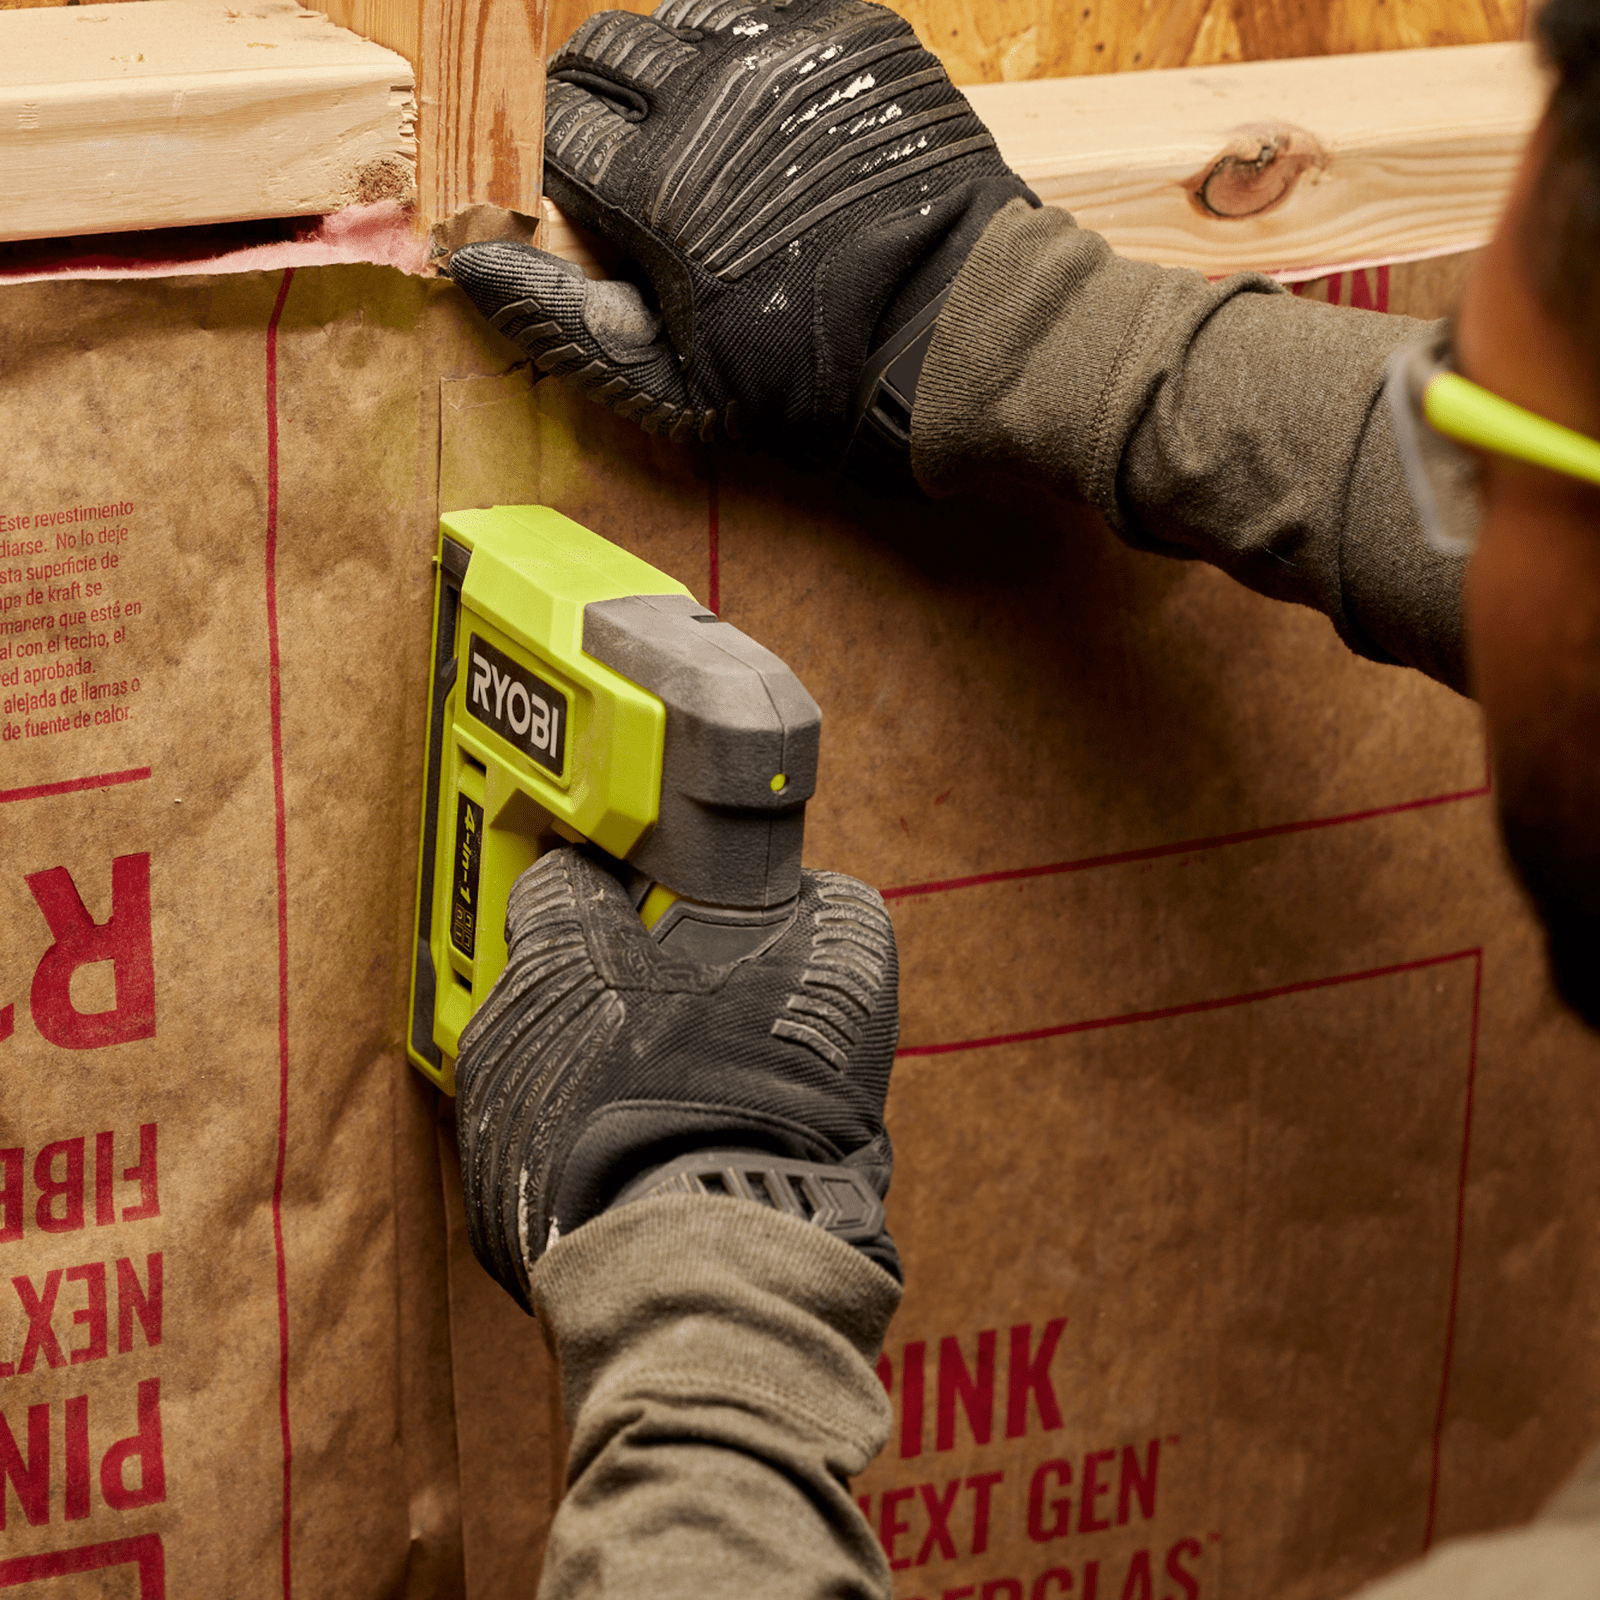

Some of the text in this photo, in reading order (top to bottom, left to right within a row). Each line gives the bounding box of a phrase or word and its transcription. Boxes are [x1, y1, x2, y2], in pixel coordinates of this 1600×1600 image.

[0, 501, 134, 533] Este revestimiento
[0, 525, 129, 559] diarse. No lo deje
[0, 551, 119, 585] sta superficie de
[25, 587, 44, 606] de
[48, 581, 82, 604] kraft
[85, 581, 103, 598] se
[0, 600, 142, 636] manera que esté en
[0, 625, 126, 661] al con el techo, el
[23, 656, 96, 687] aprobada.
[4, 677, 140, 716] alejada de llamas o
[472, 652, 559, 760] RYOBI
[2, 704, 134, 742] de fuente de calor.
[458, 803, 476, 905] 4-in-1
[0, 1252, 163, 1377] NEX
